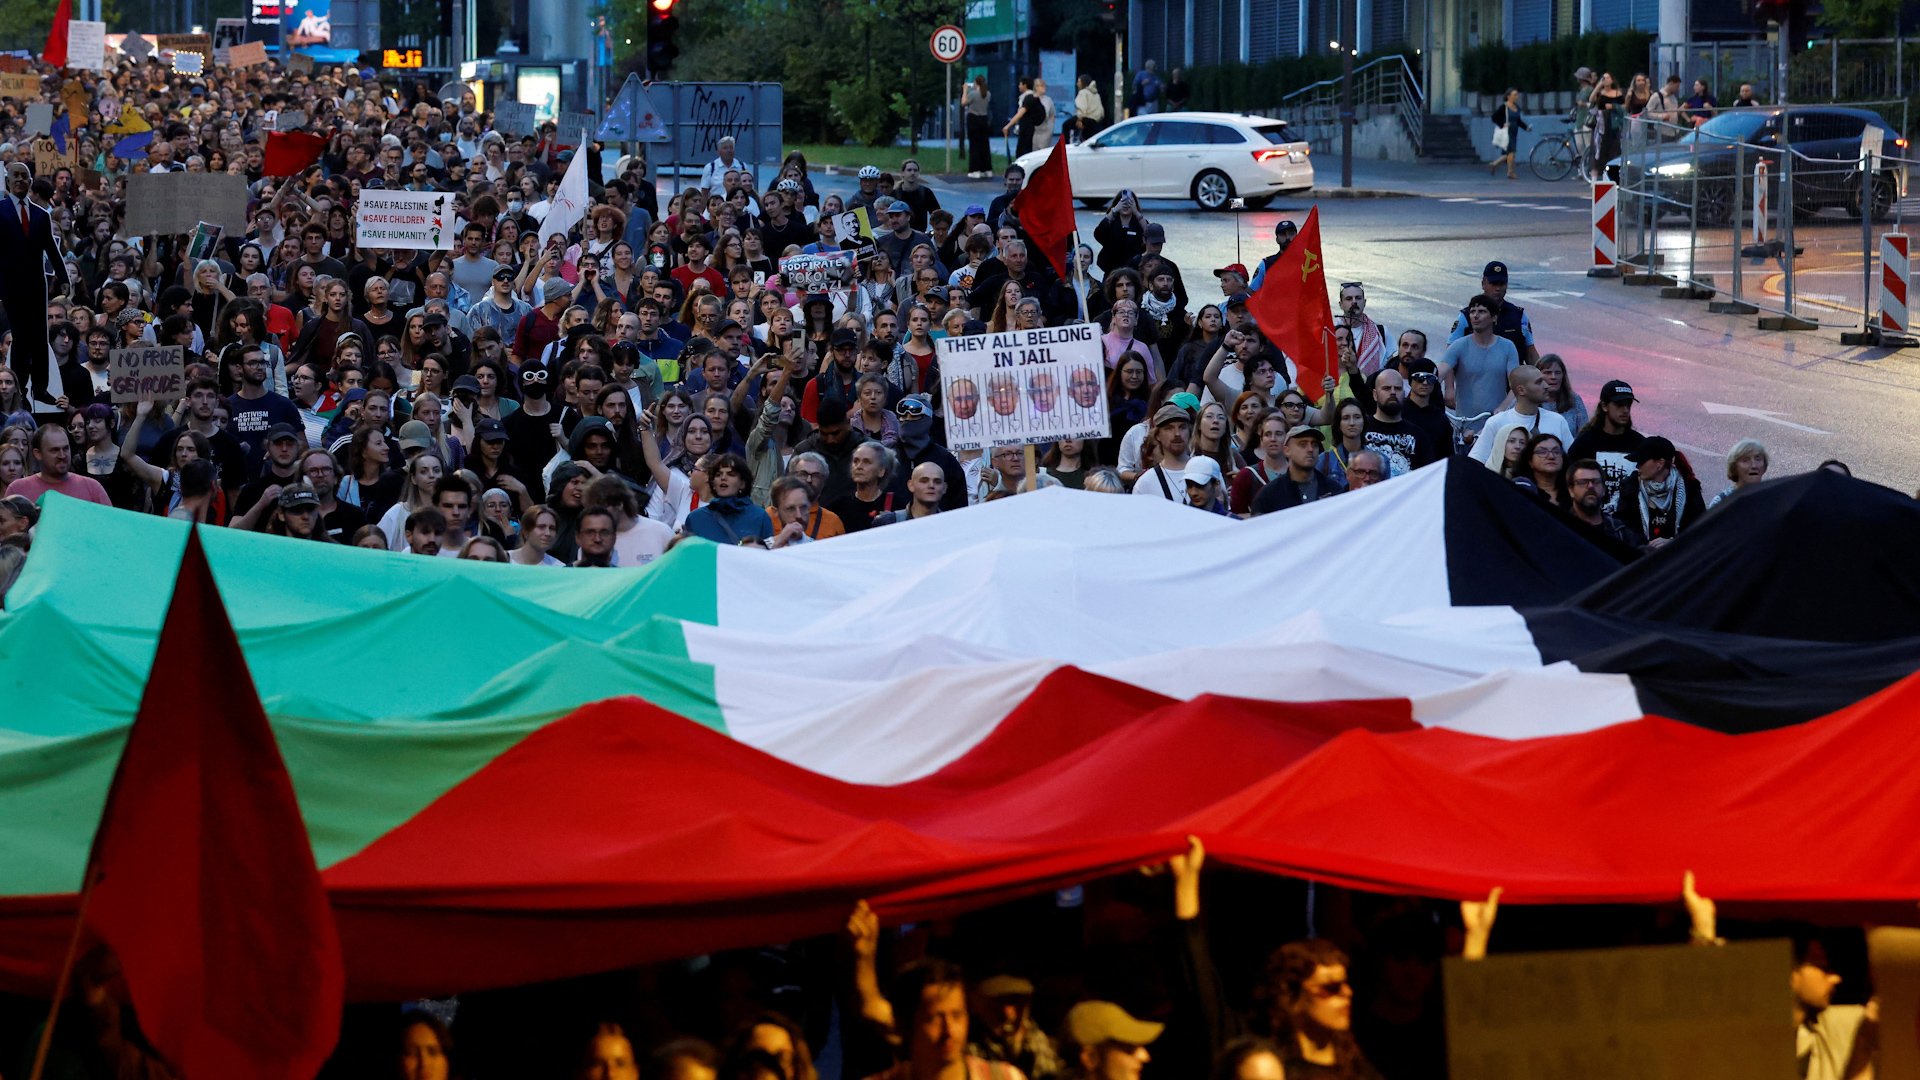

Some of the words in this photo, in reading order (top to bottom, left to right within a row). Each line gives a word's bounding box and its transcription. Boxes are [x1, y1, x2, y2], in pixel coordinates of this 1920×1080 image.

[938, 35, 957, 52] 60
[38, 140, 74, 152] KOCA
[363, 200, 389, 209] #SAVE
[390, 201, 428, 211] PALESTINE
[363, 214, 388, 223] #SAVE
[389, 215, 426, 224] CHILDREN
[362, 230, 386, 238] #SAVE
[388, 231, 427, 240] HUMANITY
[781, 260, 842, 272] PODPIRATE
[789, 271, 830, 283] POKOL
[837, 269, 845, 279] V
[807, 281, 842, 293] GAZI
[945, 337, 987, 353] THEY
[992, 333, 1022, 349] ALL
[1027, 327, 1092, 345] BELONG
[118, 352, 140, 368] NO
[142, 349, 181, 367] PRIDE
[993, 351, 1013, 368] IN
[1019, 348, 1057, 366] JAIL
[130, 369, 140, 377] IN
[113, 373, 181, 395] GENOCIDE
[954, 442, 981, 450] PUTIN
[992, 438, 1022, 447] TRUMP
[1026, 433, 1071, 443] NETANYAHU
